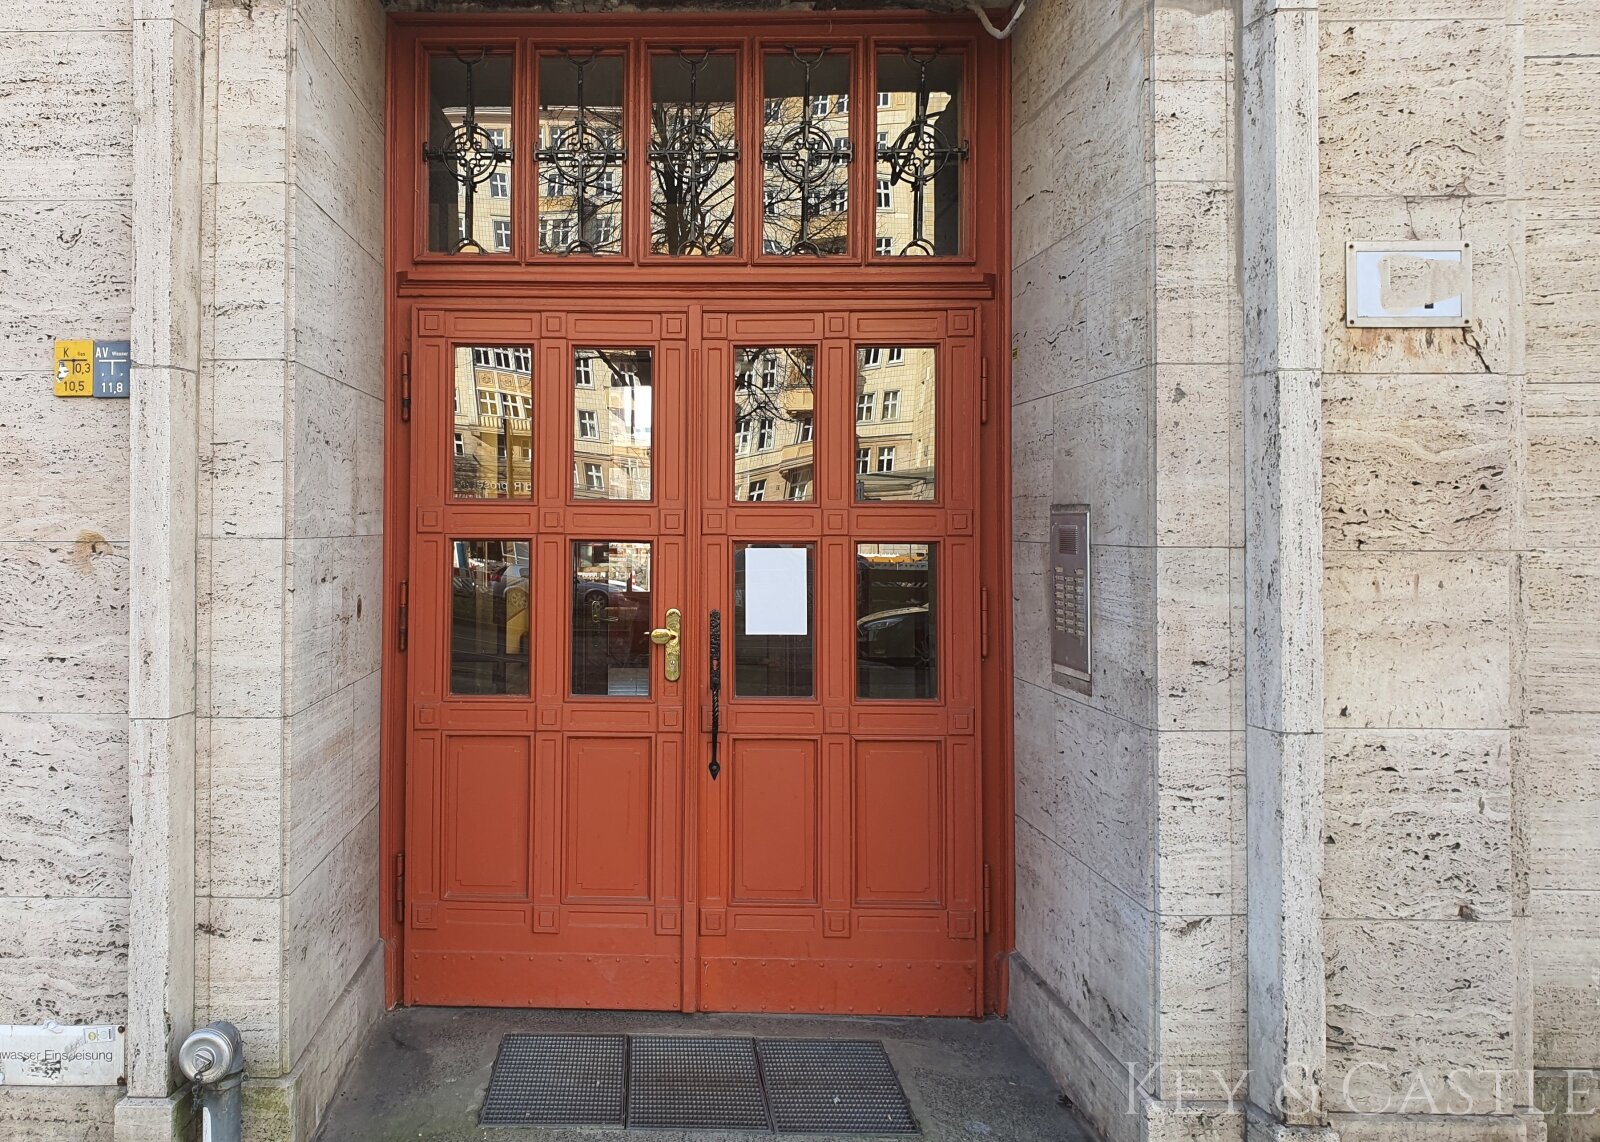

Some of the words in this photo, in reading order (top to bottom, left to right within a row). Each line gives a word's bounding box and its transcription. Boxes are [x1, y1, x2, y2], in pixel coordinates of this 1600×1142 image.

[63, 348, 69, 358] K
[95, 347, 109, 358] AV
[63, 381, 85, 393] 10,5
[101, 382, 123, 394] 11,8
